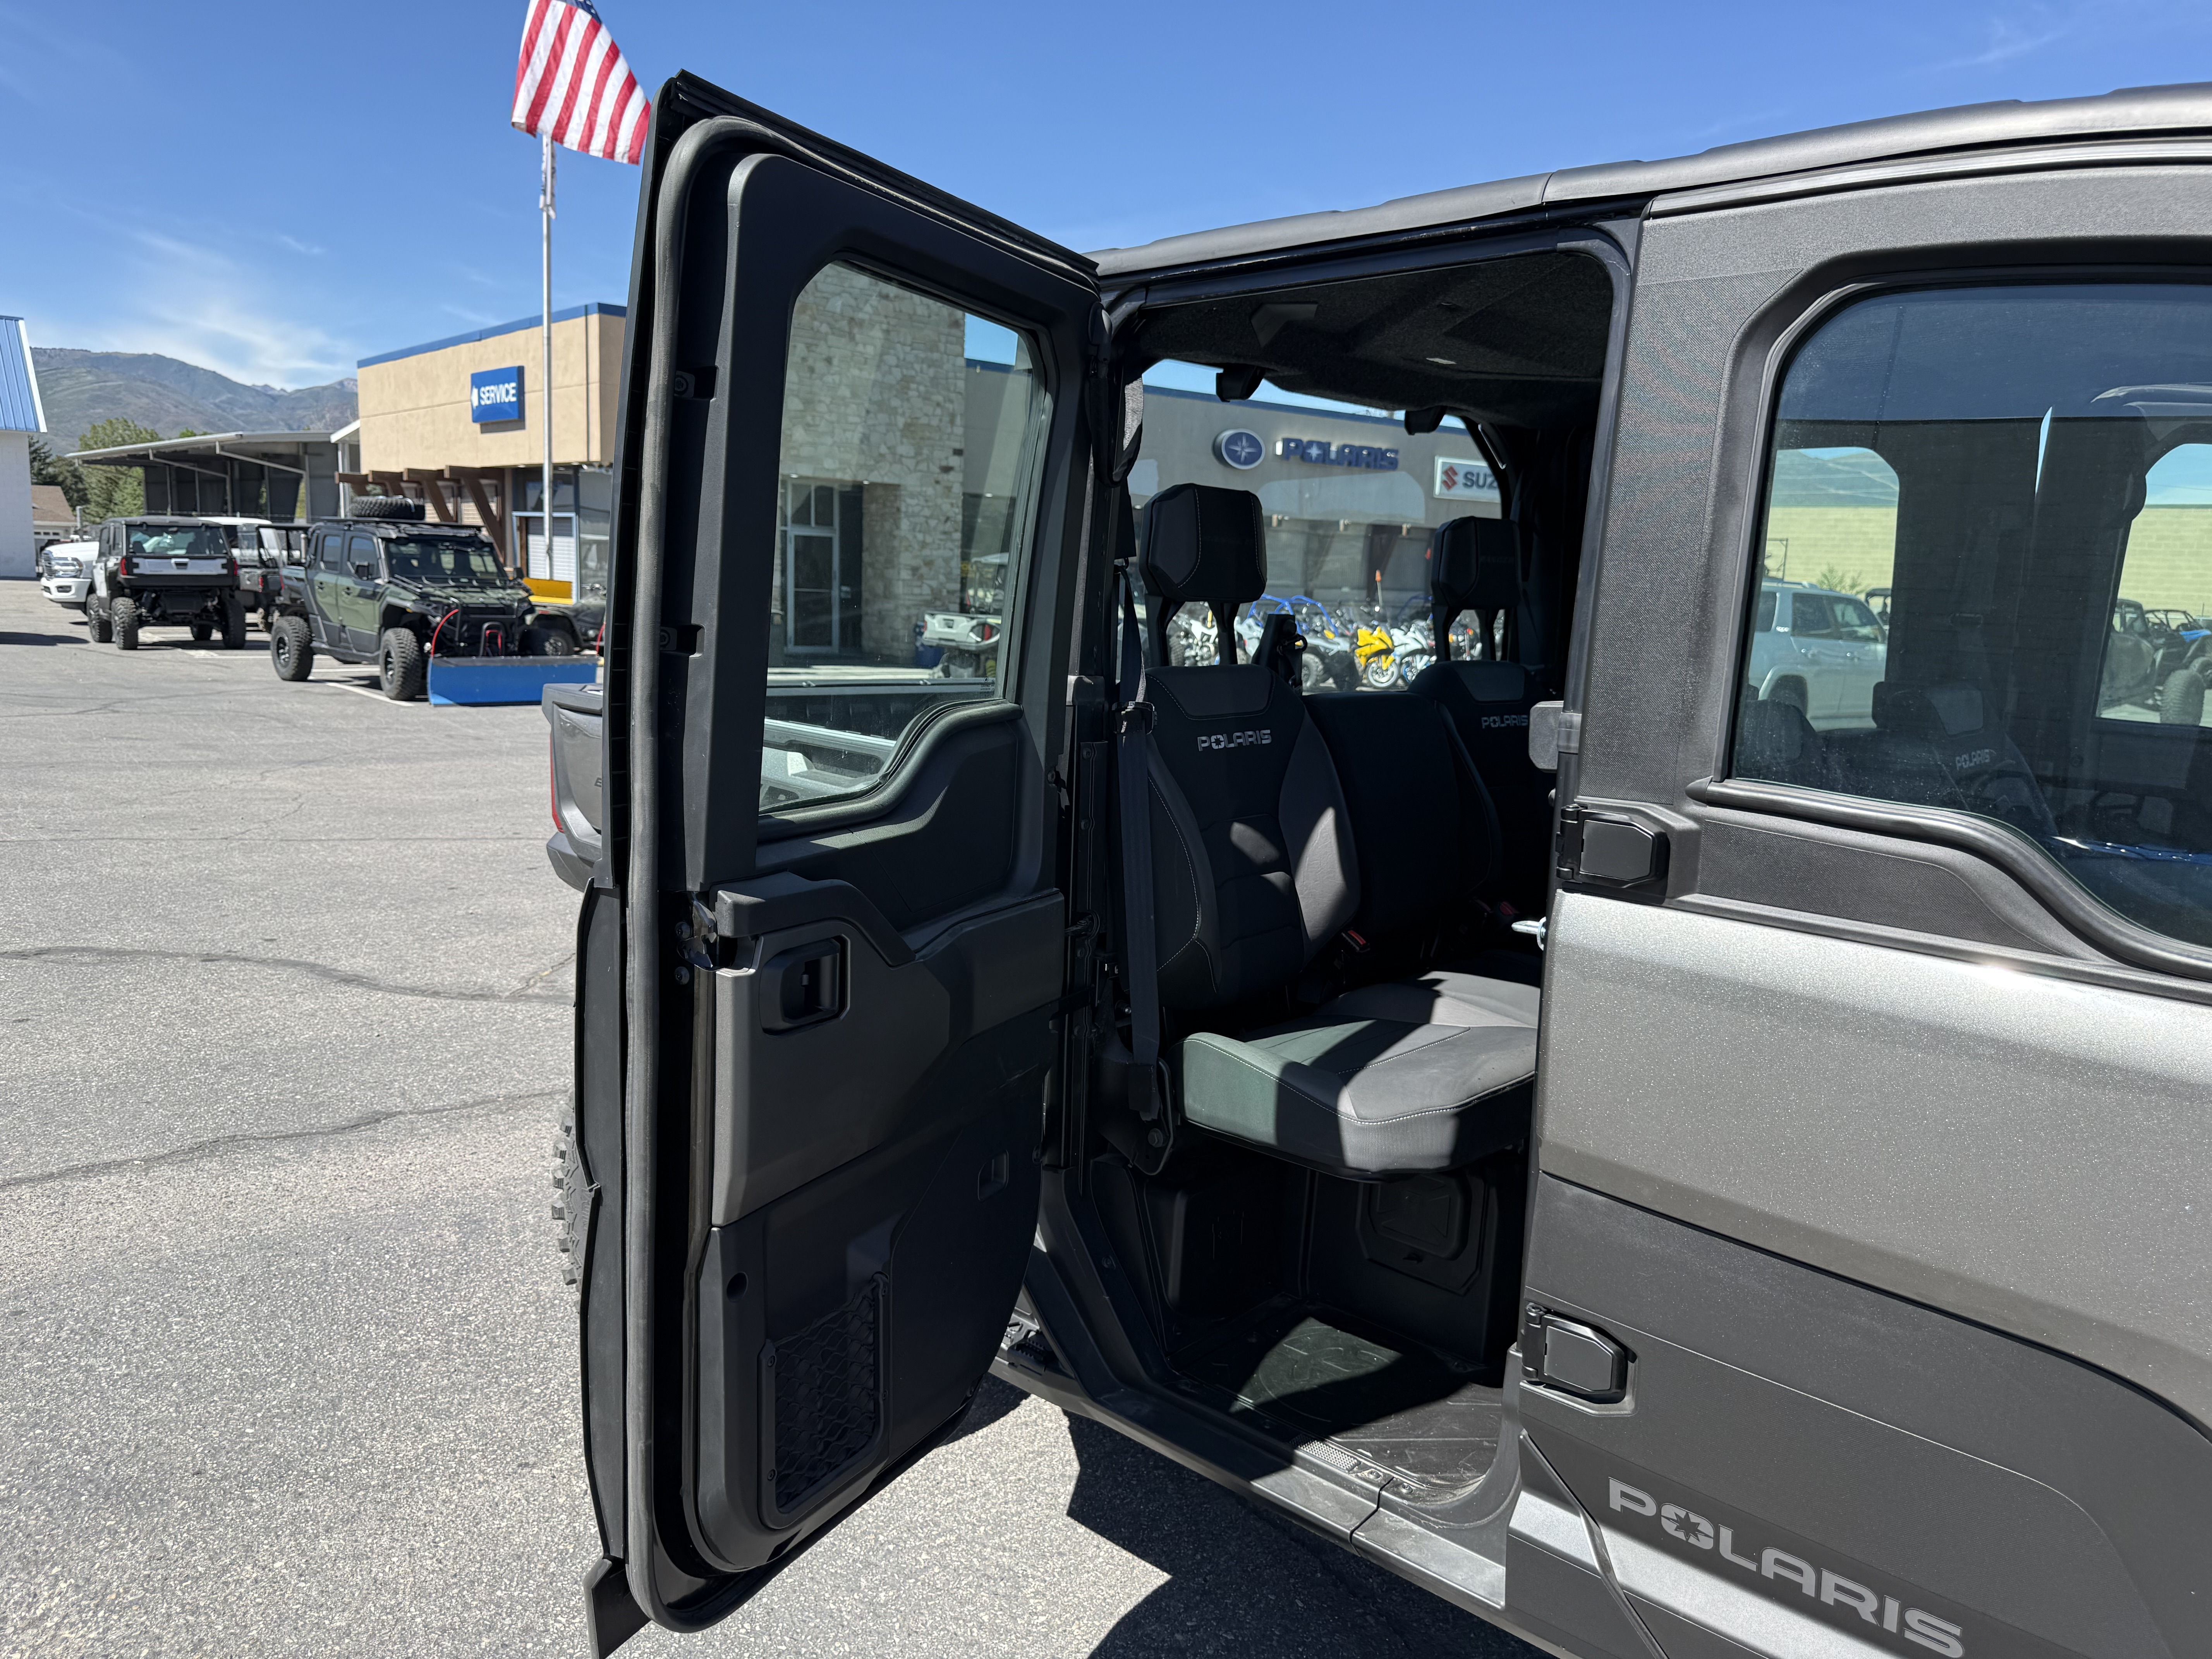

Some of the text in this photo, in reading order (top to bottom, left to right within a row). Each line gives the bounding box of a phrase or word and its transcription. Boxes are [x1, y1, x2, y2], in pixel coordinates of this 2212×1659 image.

[480, 382, 517, 405] SERVICE
[1282, 438, 1399, 471] POLARIS
[1462, 472, 1498, 489] SUZ
[1481, 715, 1528, 728] POLARIS
[1197, 730, 1272, 751] POLARIS
[1956, 749, 1990, 770] POLARIS
[1608, 1477, 1965, 1658] POLARIS
